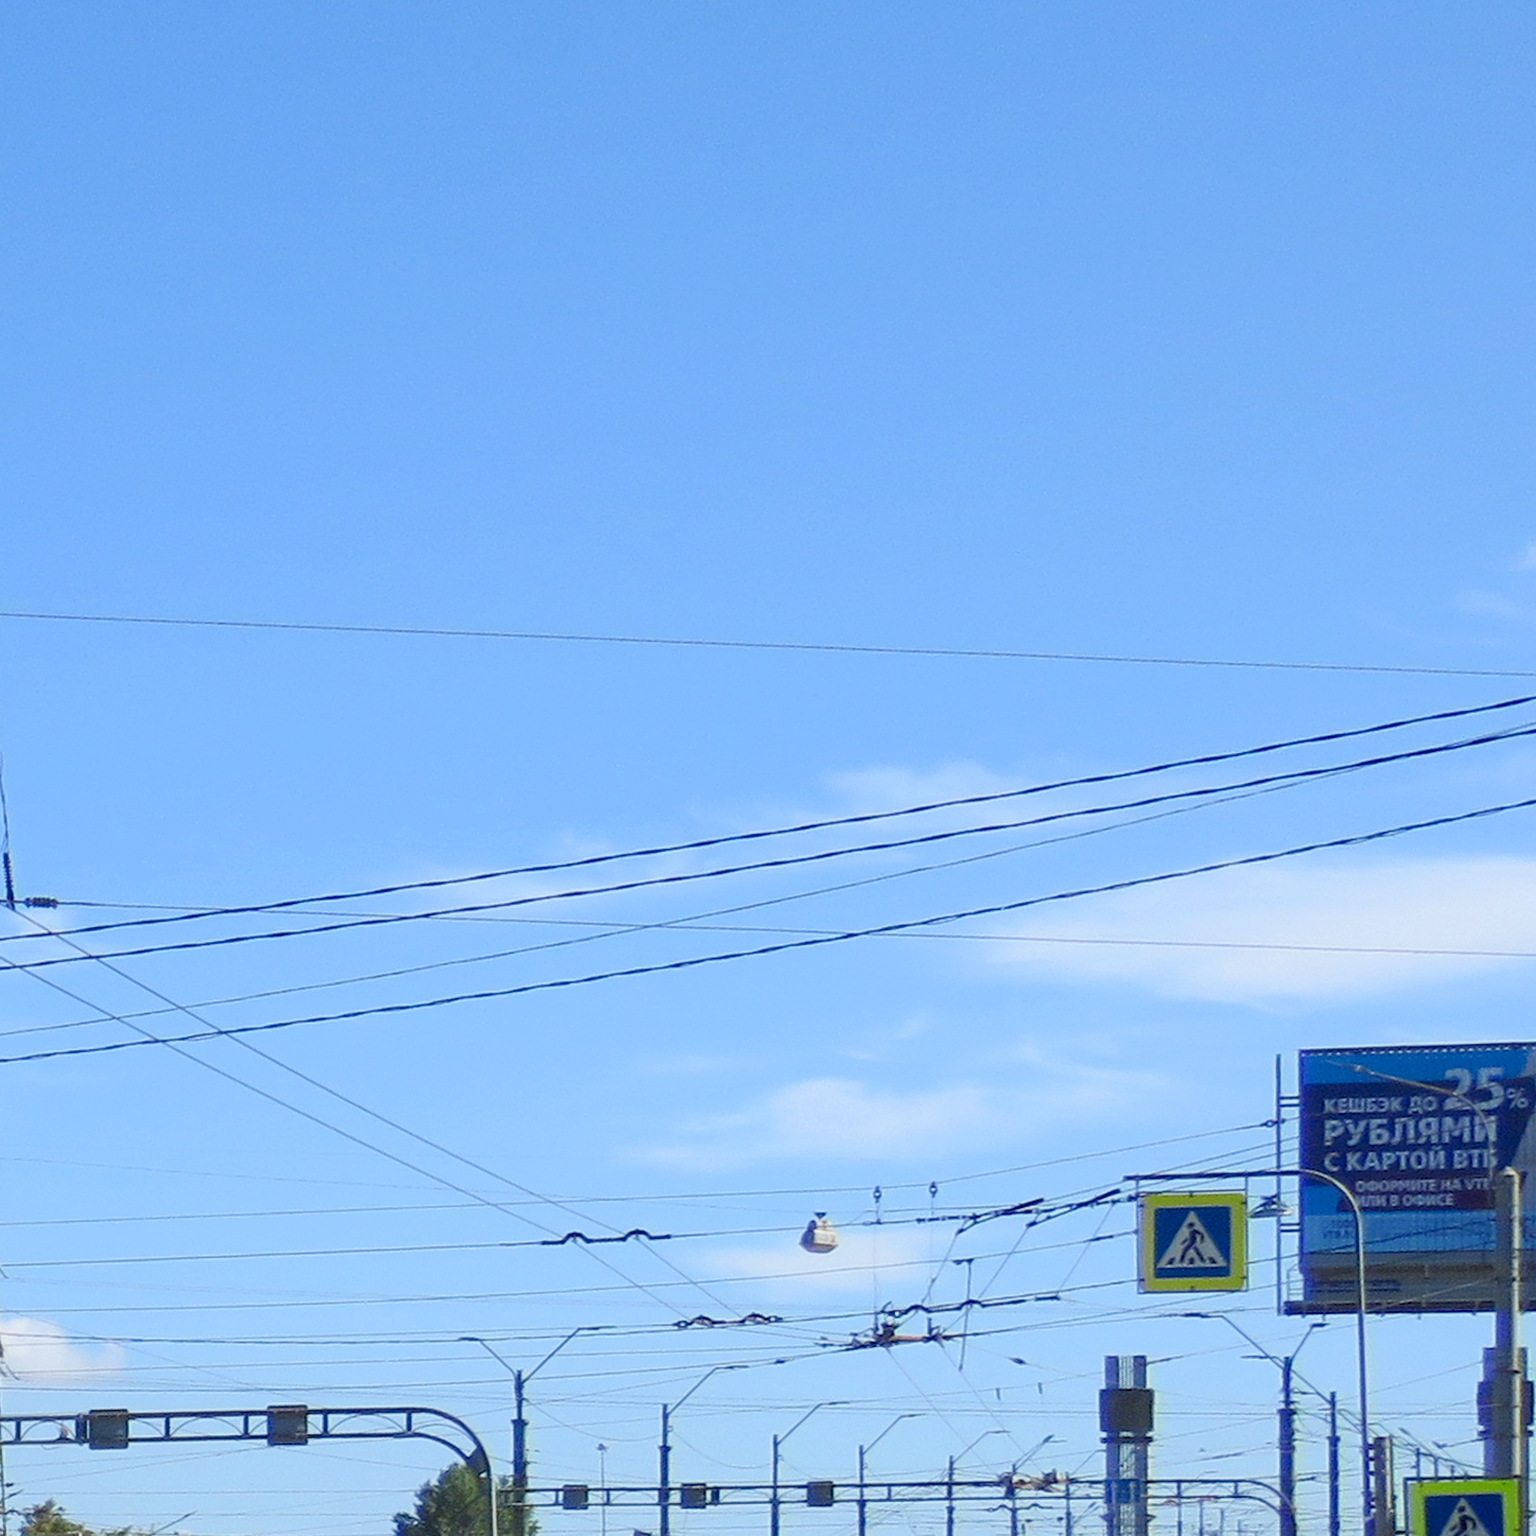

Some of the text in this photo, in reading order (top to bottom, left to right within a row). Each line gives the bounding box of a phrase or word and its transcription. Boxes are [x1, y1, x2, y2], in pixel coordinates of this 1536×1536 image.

[1323, 1095, 1404, 1114] КЕШБЭК
[1408, 1095, 1438, 1115] ДО
[1323, 1115, 1498, 1147] РУБЛЯМИ
[1323, 1146, 1499, 1172] С КАРТОЙ ВТБ
[1355, 1178, 1438, 1194] ОФОРМИТЕ
[1440, 1178, 1463, 1192] НА
[1390, 1194, 1400, 1207] В
[1402, 1193, 1455, 1207] ОФИСЕ
